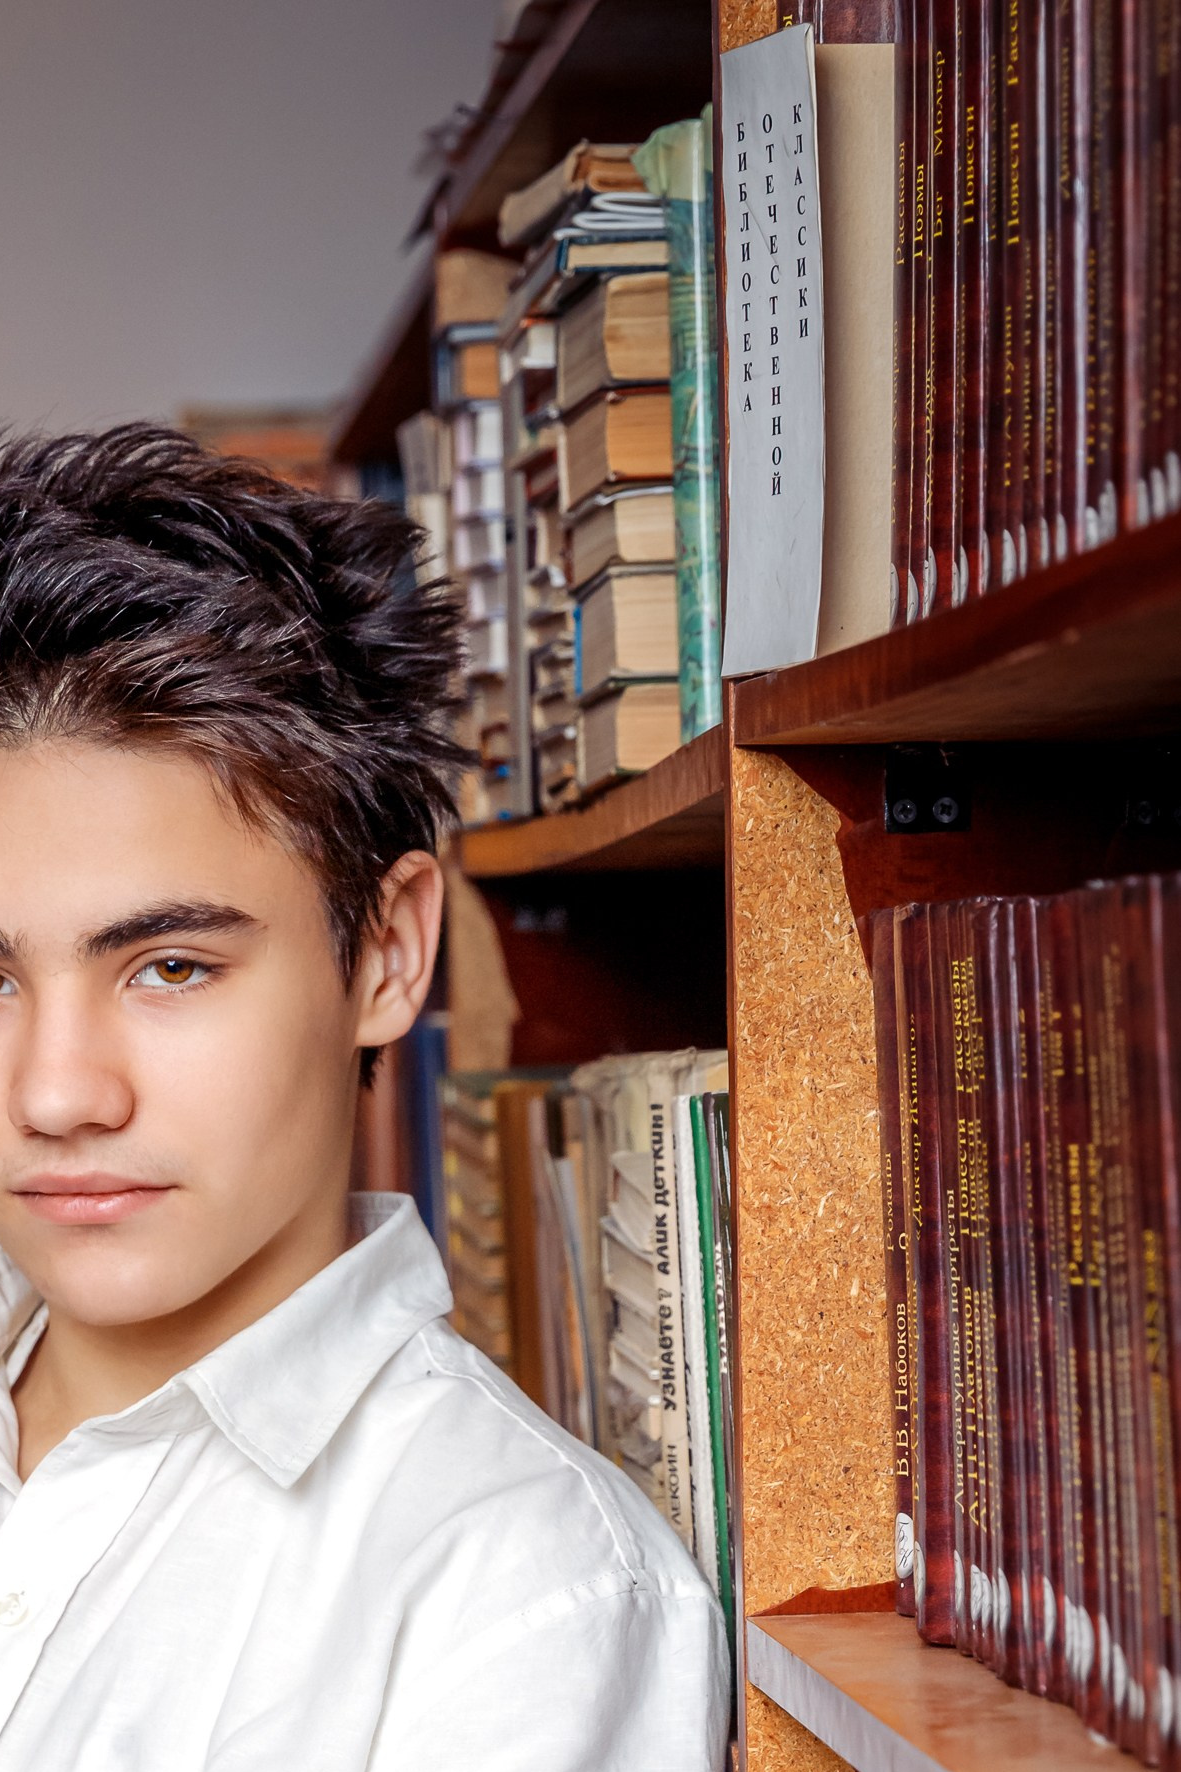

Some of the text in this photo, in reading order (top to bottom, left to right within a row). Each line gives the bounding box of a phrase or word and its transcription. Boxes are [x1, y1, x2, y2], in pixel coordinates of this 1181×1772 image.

[896, 140, 906, 265] Рассказы
[933, 49, 946, 238] Бег Мольер
[963, 105, 974, 224] Повести
[1006, 121, 1020, 247] Повести
[735, 121, 753, 414] БИБЛИОТЕКА
[792, 103, 809, 338] КЛАССИКИ
[913, 164, 924, 259] Поэмы
[761, 111, 782, 497] ОТЕЧЕСТВЕННОЙ
[655, 1213, 670, 1276] АЛИК
[885, 1153, 895, 1252] Романы
[912, 1133, 923, 1242] «Доктор
[951, 960, 979, 1526] А. П. Платонов Повести Рассказы
[894, 1303, 909, 1412] Набоков
[946, 1188, 966, 1514] Литературные портреты
